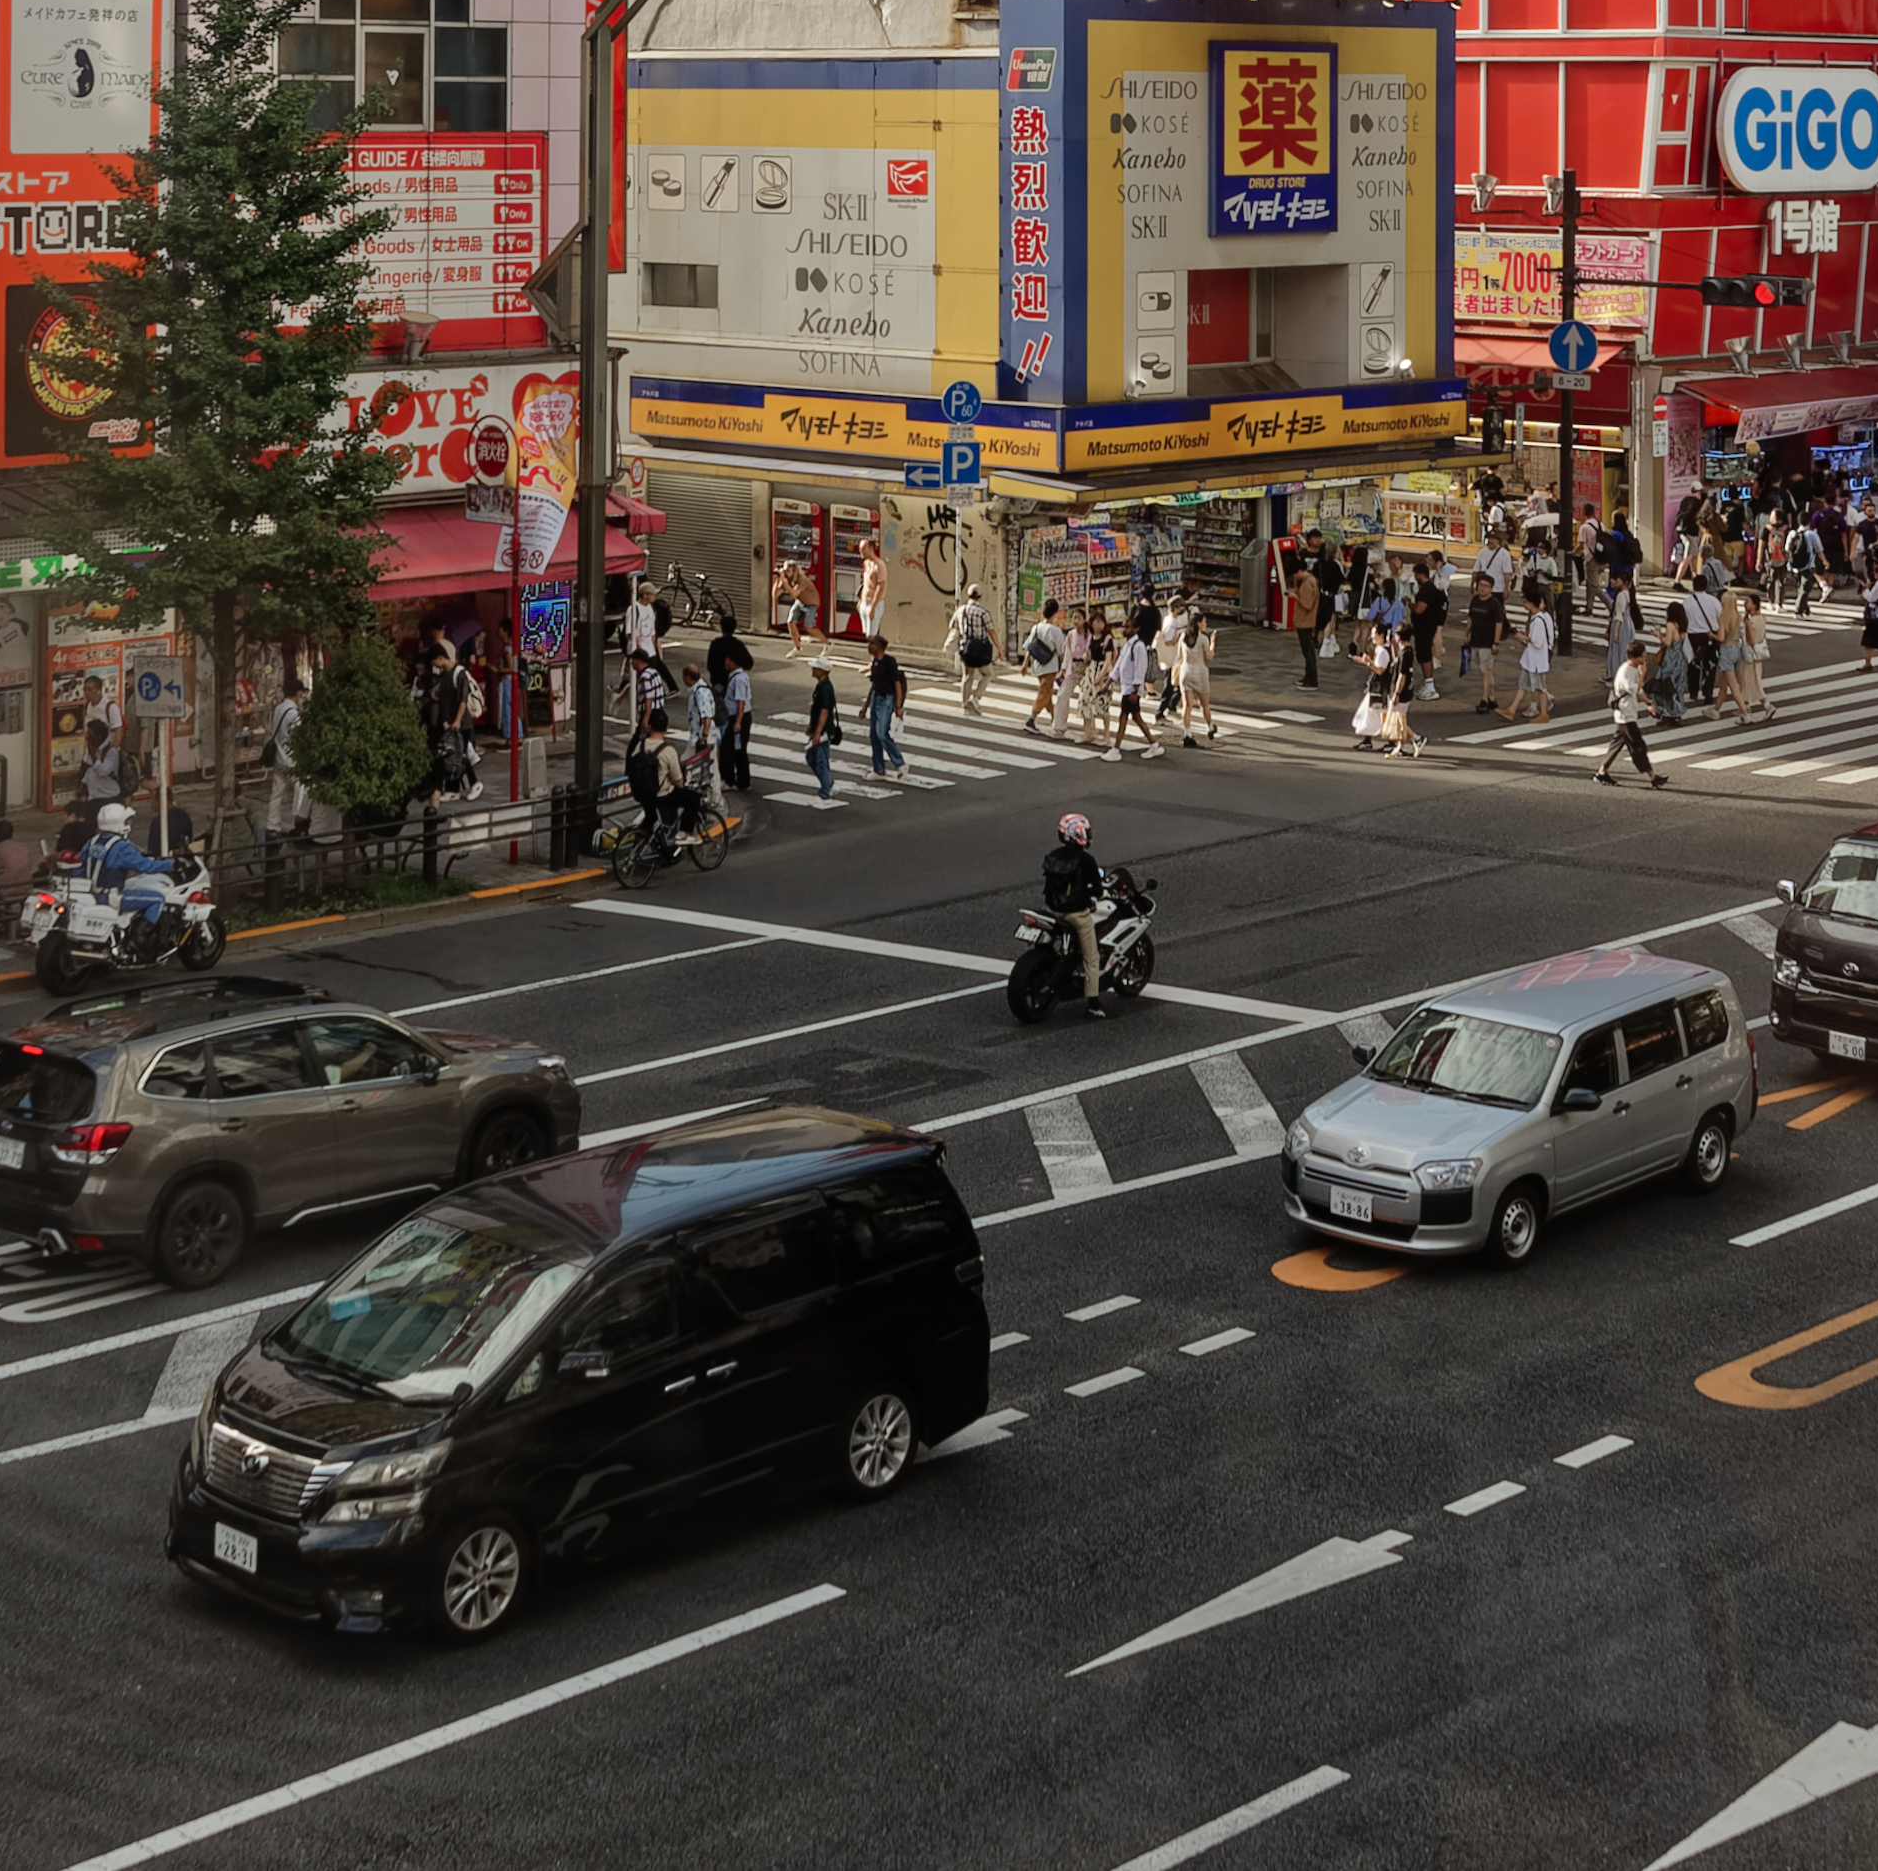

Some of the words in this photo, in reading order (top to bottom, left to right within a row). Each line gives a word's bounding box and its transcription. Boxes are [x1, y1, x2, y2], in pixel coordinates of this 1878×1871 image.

[23, 7, 138, 23] メイドカフェ発祥の店
[1012, 58, 1052, 72] UnionPay
[21, 70, 64, 86] CURE
[1100, 77, 1198, 100] SHISEIDO
[1340, 80, 1427, 101] SHISEIDO
[1141, 112, 1190, 134] KOSÉ
[1238, 57, 1318, 169] 薬
[358, 151, 407, 167] GUIDE
[1112, 146, 1186, 170] Kanebo
[1351, 145, 1417, 167] Kanebo
[1248, 177, 1275, 189] DRUG
[1276, 176, 1306, 189] STORE
[1356, 180, 1414, 199] SOFINA
[1117, 184, 1183, 204] SOFINA
[509, 208, 527, 220] Only
[1223, 191, 1331, 230] マツモトキヨシ
[1768, 200, 1840, 255] 1号館
[364, 238, 415, 255] Goods
[785, 228, 908, 258] SHISEIDO
[516, 268, 529, 278] OK
[834, 269, 894, 296] KOSÉ
[797, 307, 891, 338] Kanebo
[798, 351, 881, 377] SOFINA
[951, 391, 966, 417] P
[646, 410, 716, 431] Matsumoto
[718, 416, 763, 434] KiYoshi
[780, 406, 888, 444] マツモトキヨシ
[1087, 438, 1162, 457] Matsumoto
[1164, 433, 1209, 450] KiYoshi
[1227, 410, 1325, 447] マツモトキヨシ
[1343, 415, 1408, 435] Matsumoto
[1410, 412, 1451, 430] KiYoshi
[477, 441, 507, 462] 消火栓
[951, 445, 974, 481] P
